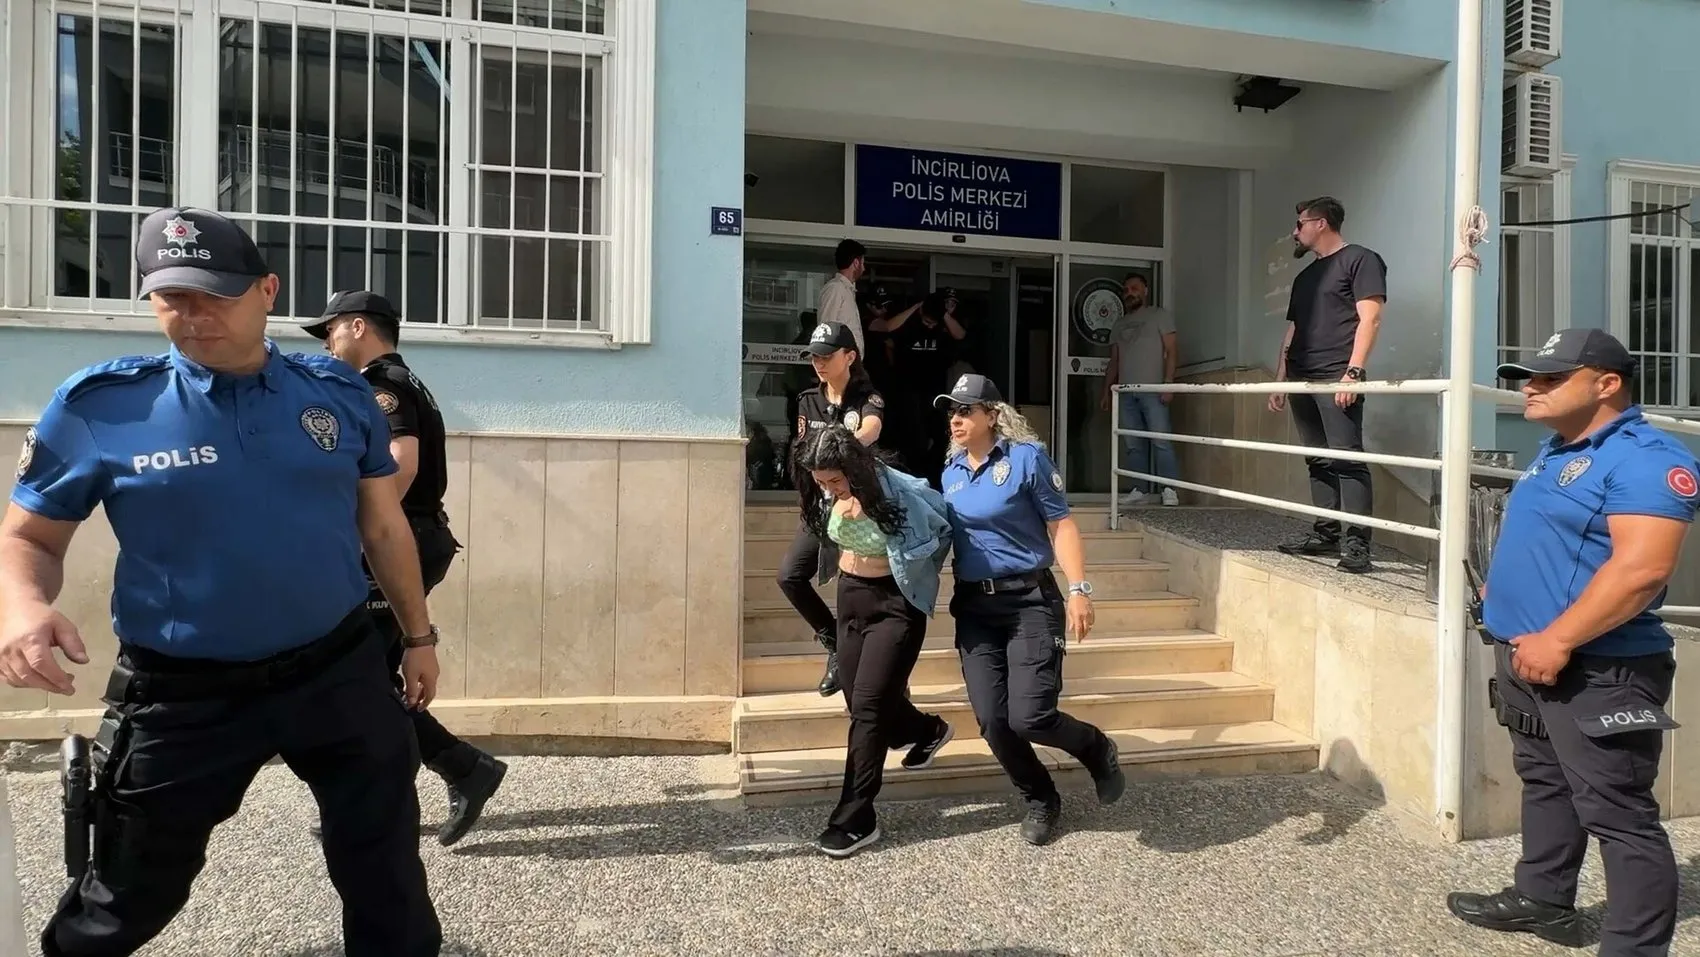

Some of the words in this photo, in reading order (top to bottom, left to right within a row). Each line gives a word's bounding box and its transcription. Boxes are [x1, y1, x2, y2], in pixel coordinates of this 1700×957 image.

[911, 155, 1011, 183] İNCİRLİOVA
[892, 182, 945, 202] POLİS
[950, 186, 1028, 209] MERKEZİ
[719, 211, 735, 224] 65
[920, 208, 1000, 231] AMİRLİĞİ
